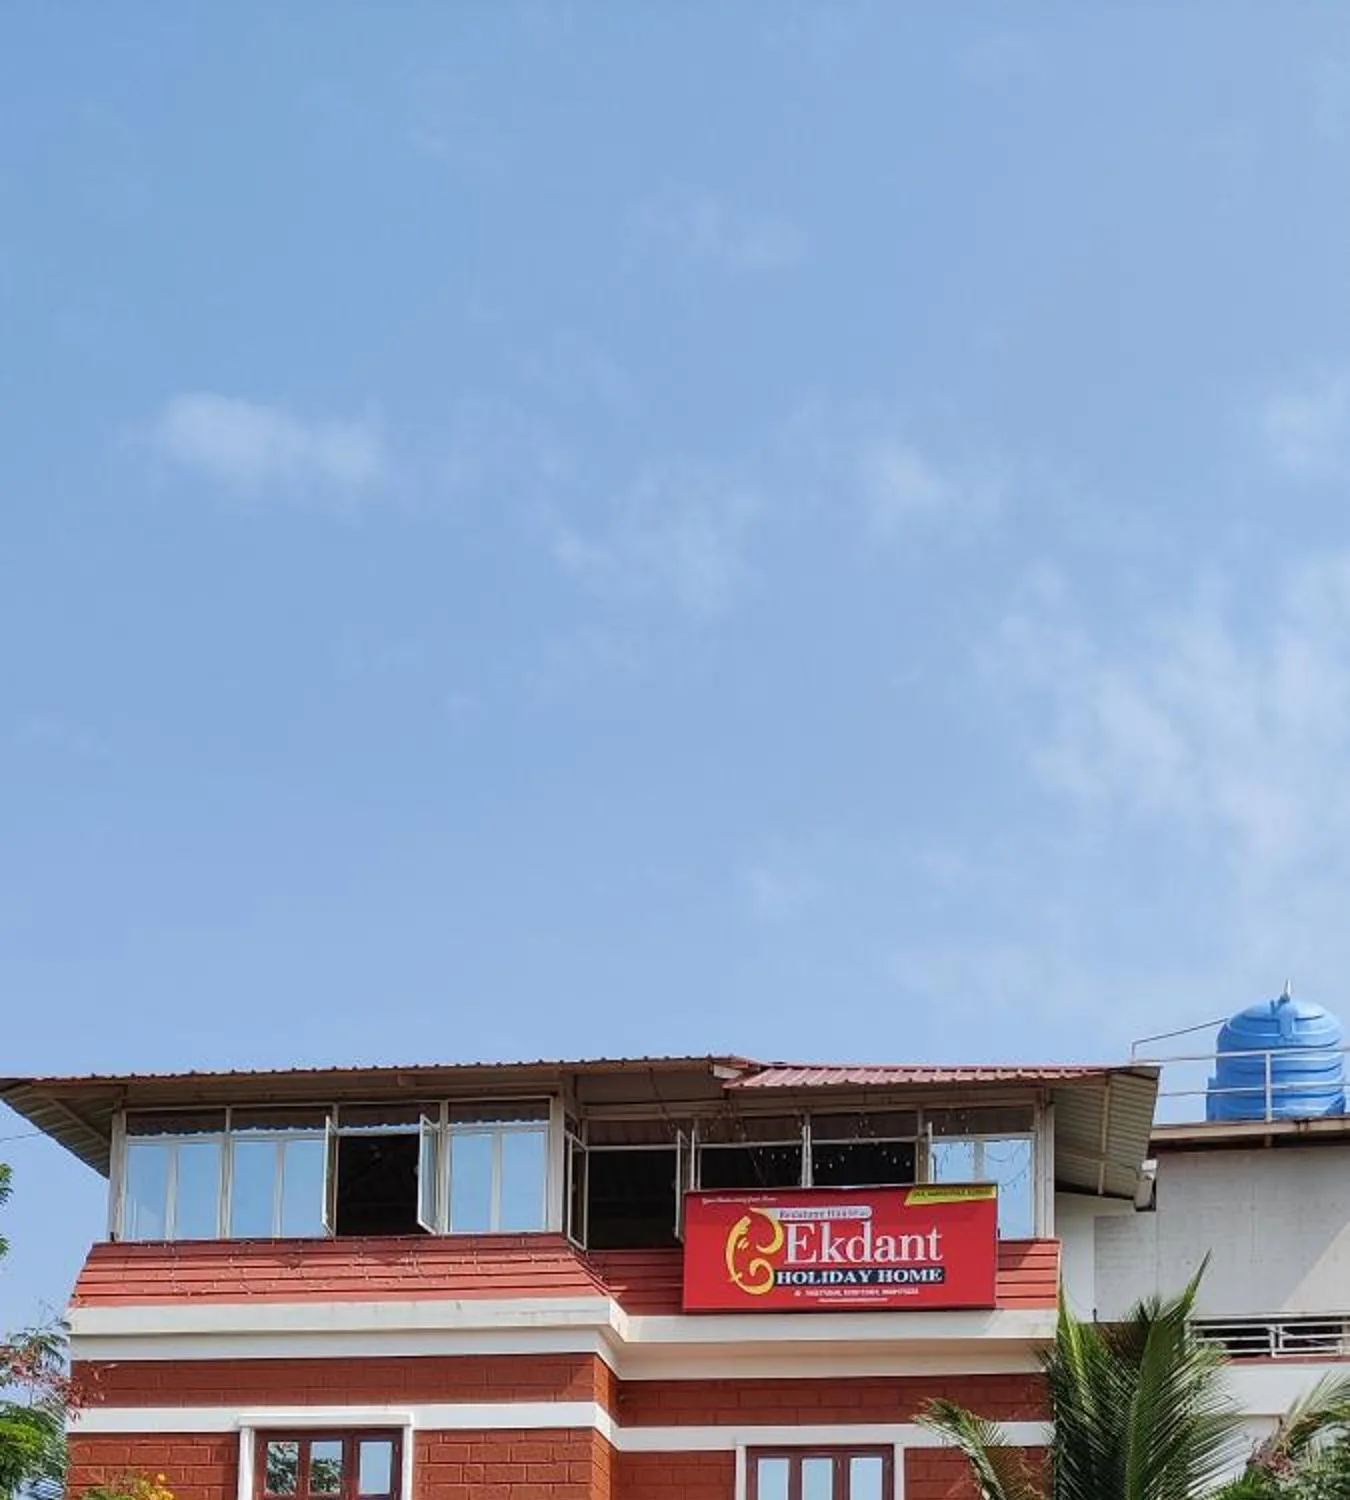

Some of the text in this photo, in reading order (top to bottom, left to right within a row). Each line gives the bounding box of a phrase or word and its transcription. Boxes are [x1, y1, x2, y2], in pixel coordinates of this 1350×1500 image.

[784, 1221, 943, 1264] Ekdant
[777, 1268, 943, 1284] HOLIDAY HOME
